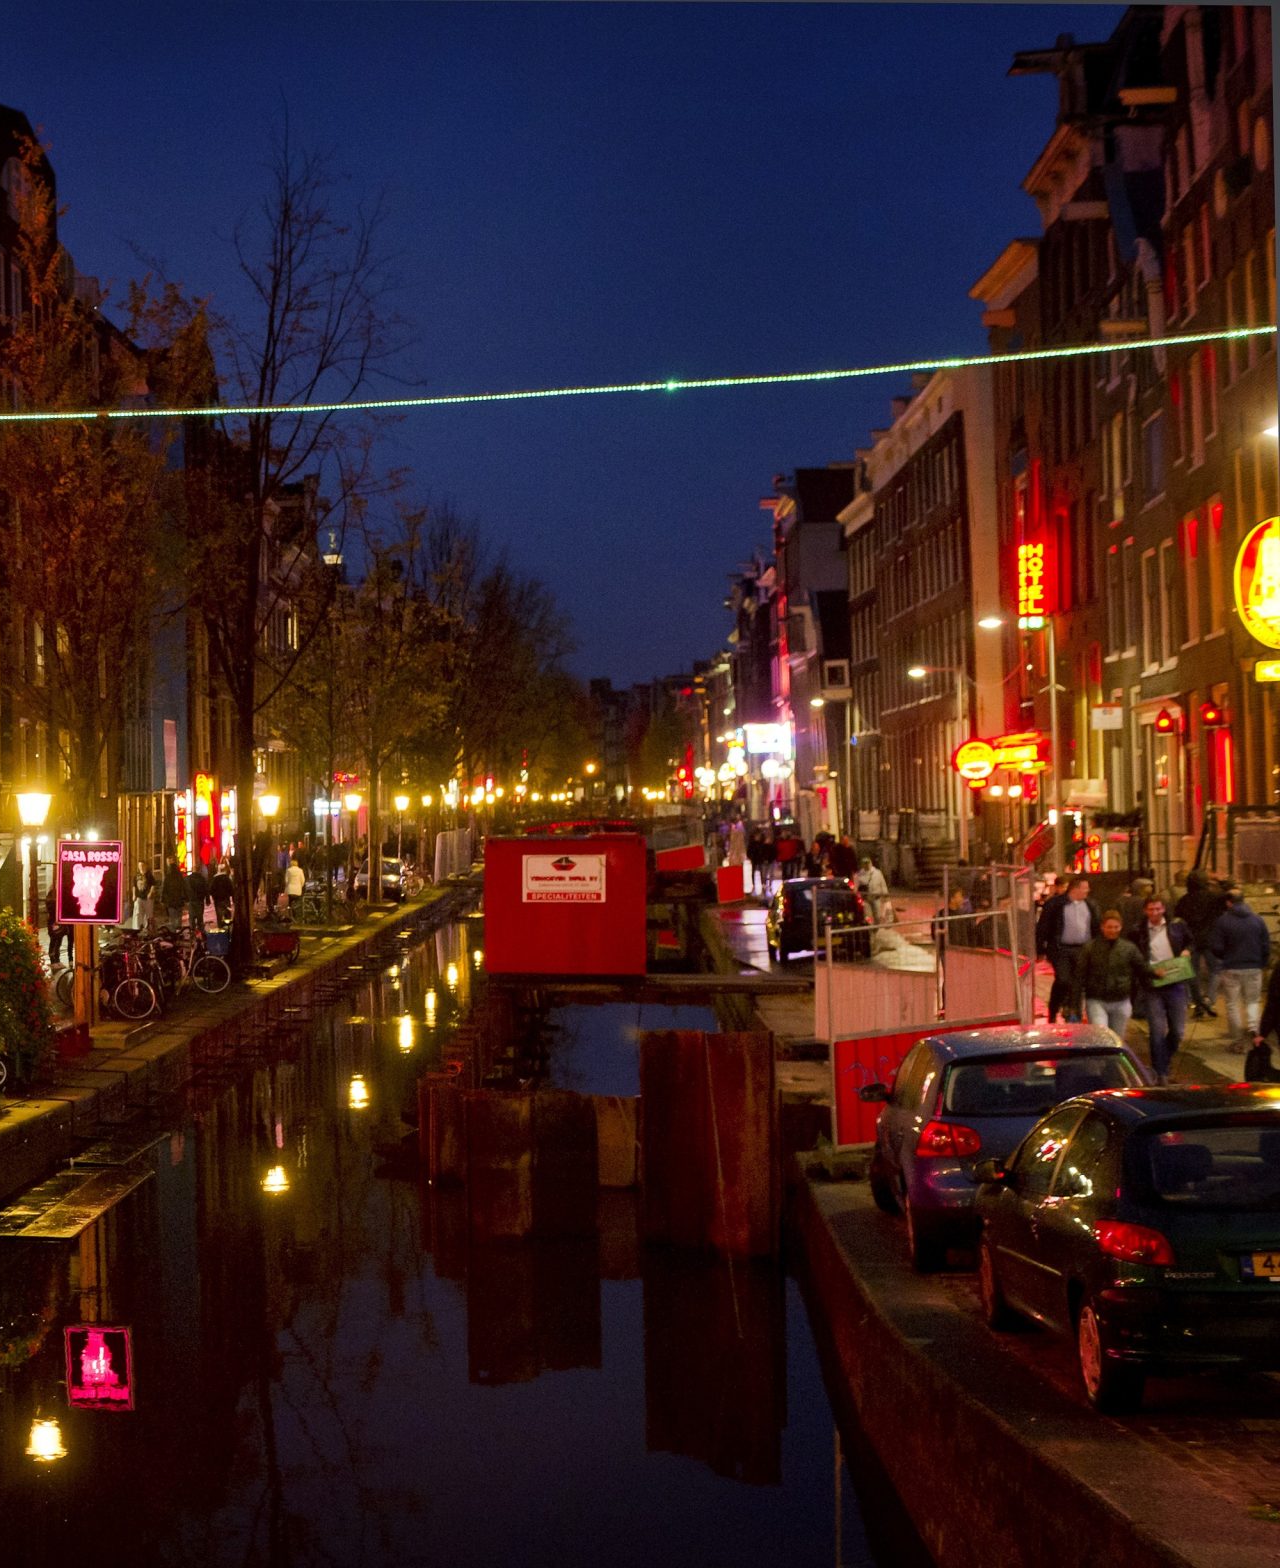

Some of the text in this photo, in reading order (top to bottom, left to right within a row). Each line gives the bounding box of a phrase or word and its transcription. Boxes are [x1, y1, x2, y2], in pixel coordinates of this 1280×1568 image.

[1027, 543, 1044, 614] HOTEL
[61, 850, 120, 862] CASA ROSSO
[531, 892, 597, 900] SPECIALITEITEN
